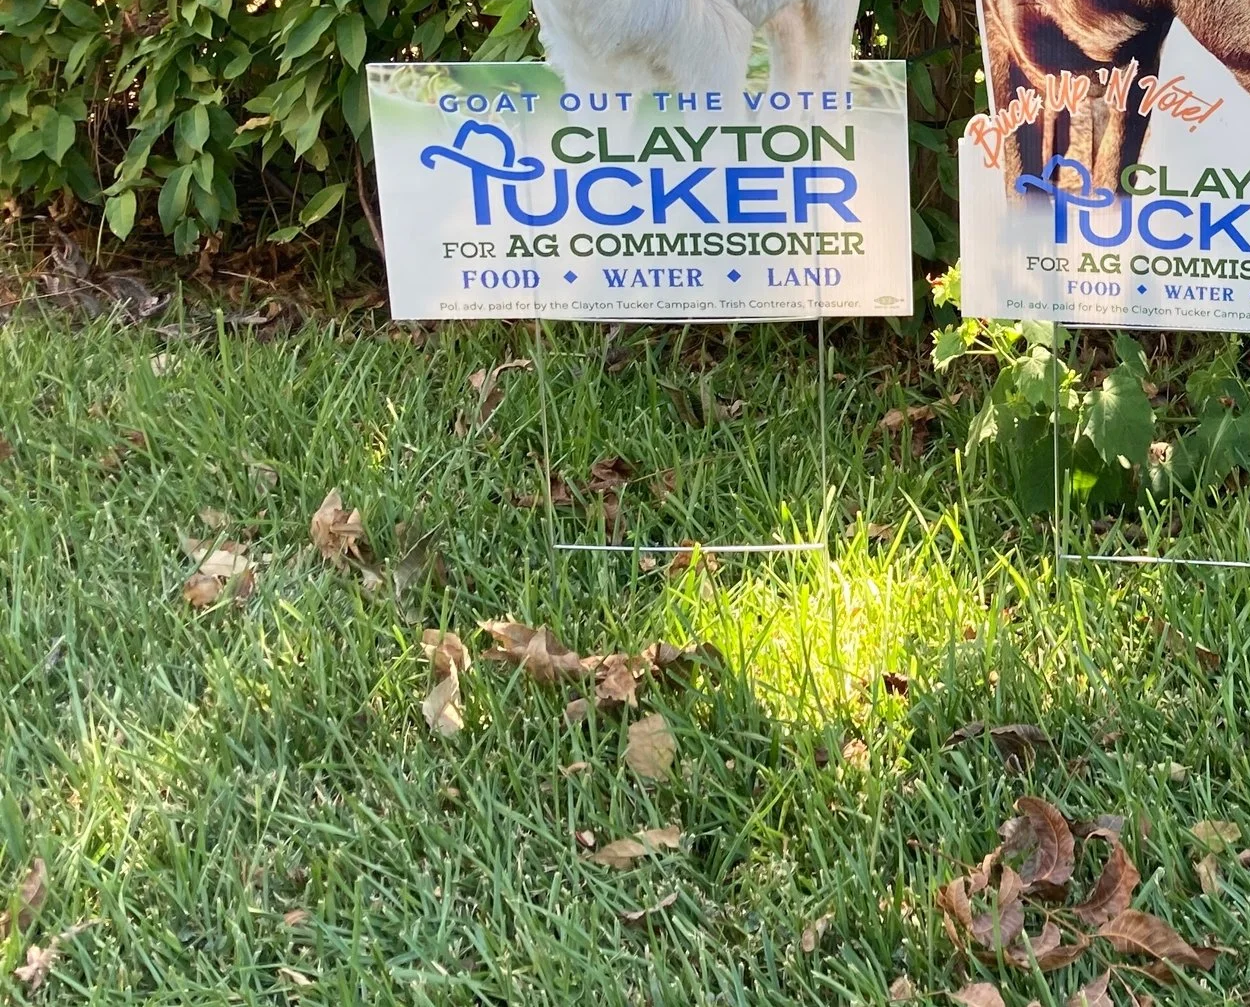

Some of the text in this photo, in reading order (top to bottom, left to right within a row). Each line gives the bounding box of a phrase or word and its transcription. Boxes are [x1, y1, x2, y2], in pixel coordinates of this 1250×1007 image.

[438, 92, 854, 113] GOAT OUT THE VOTE!
[968, 87, 1040, 168] Buck
[1139, 75, 1223, 133] Vote!
[551, 125, 855, 163] CLAYTON
[420, 142, 861, 227] TUCKER
[442, 232, 865, 259] FOR AG COMMISSIONER
[1026, 256, 1070, 272] FOR
[1077, 253, 1122, 274] AG
[461, 267, 843, 290] FOOD WATER LAND
[1067, 280, 1121, 297] FOOD
[1164, 285, 1234, 302] WATER
[489, 301, 512, 312] paid
[515, 301, 530, 310] for
[534, 301, 547, 312] by
[550, 301, 569, 310] the
[572, 300, 614, 312] Clayton
[616, 300, 654, 310] Tucker
[656, 300, 717, 311] Campaign.
[719, 299, 745, 309] Trish
[749, 299, 805, 309] Contreras,
[808, 299, 861, 309] Treasurer.
[1053, 301, 1075, 312] paid
[1078, 302, 1093, 312] for
[1096, 303, 1108, 314] by
[1111, 304, 1128, 313] the
[1132, 305, 1172, 316] Clayton
[1174, 307, 1210, 317] Tucker
